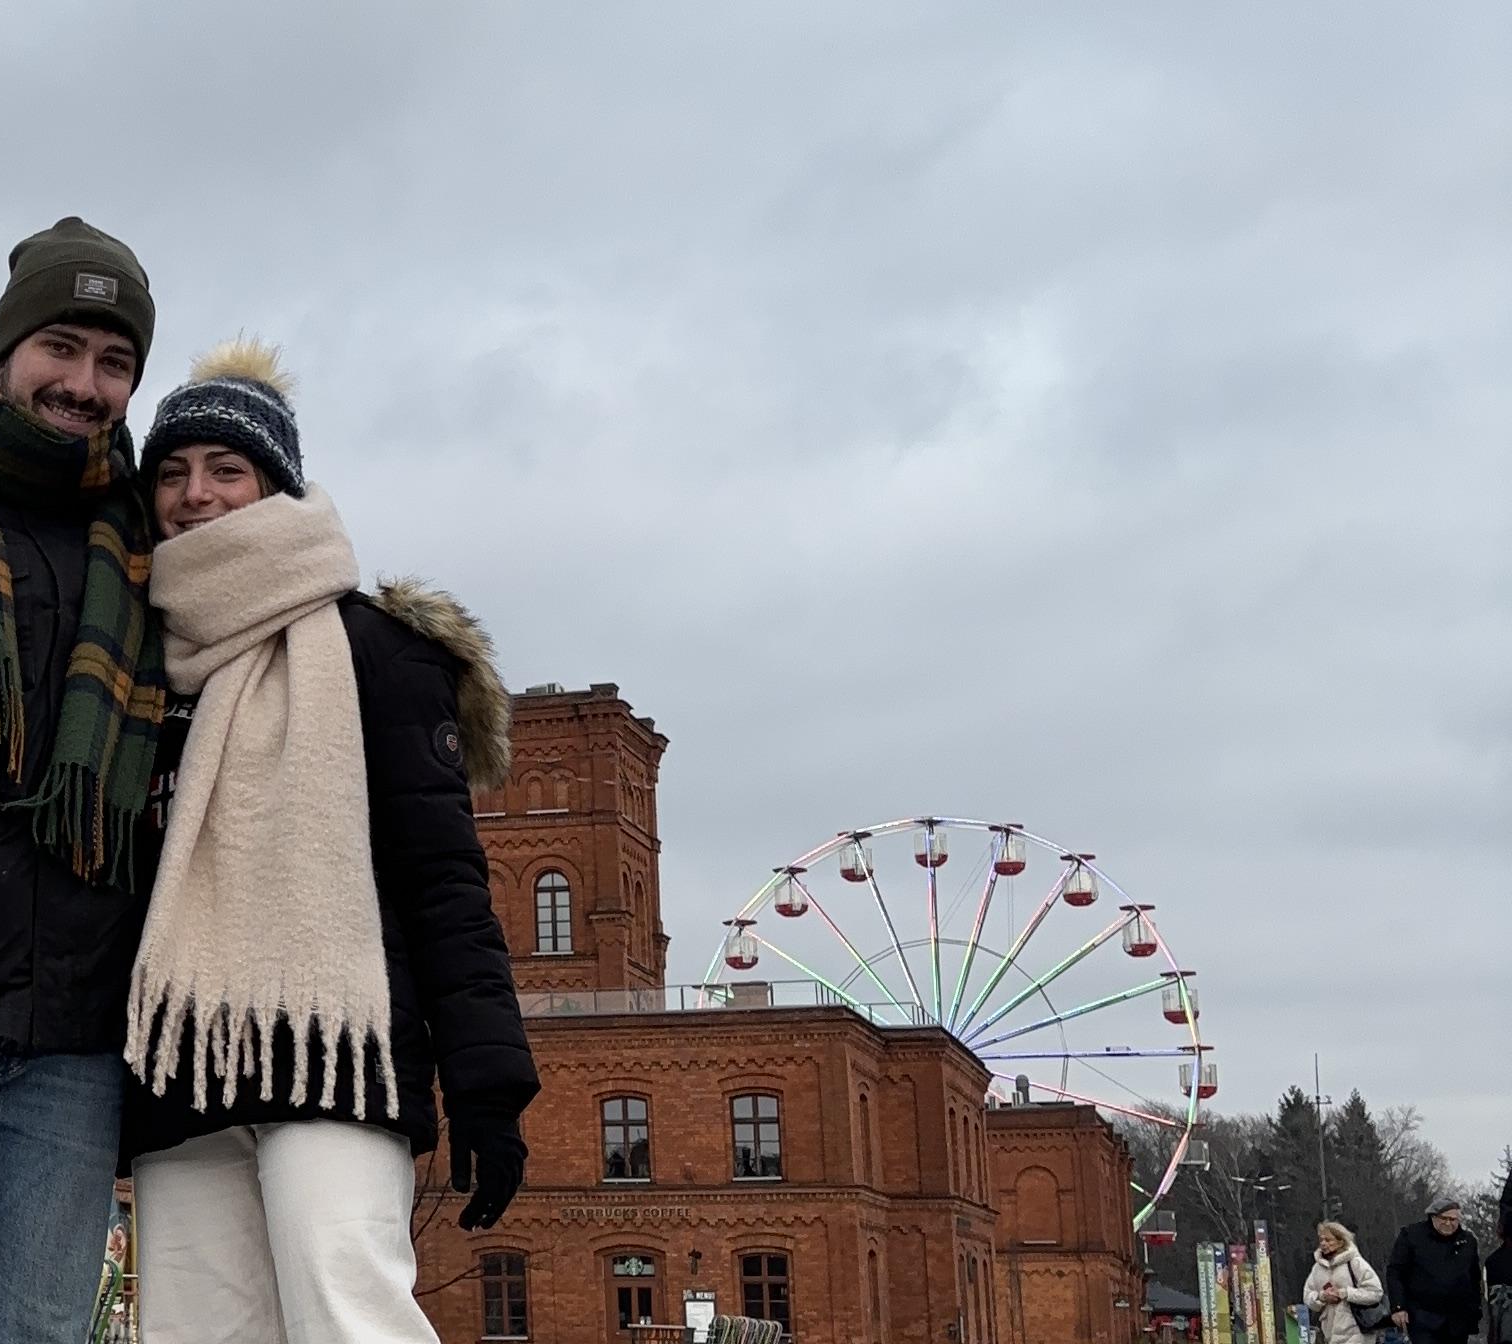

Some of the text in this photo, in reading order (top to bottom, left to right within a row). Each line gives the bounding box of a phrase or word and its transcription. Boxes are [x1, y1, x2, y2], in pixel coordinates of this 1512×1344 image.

[560, 1207, 691, 1217] STARBUCKS COFFEE
[1258, 1239, 1268, 1264] HOTEL
[1216, 1263, 1224, 1283] KINO
